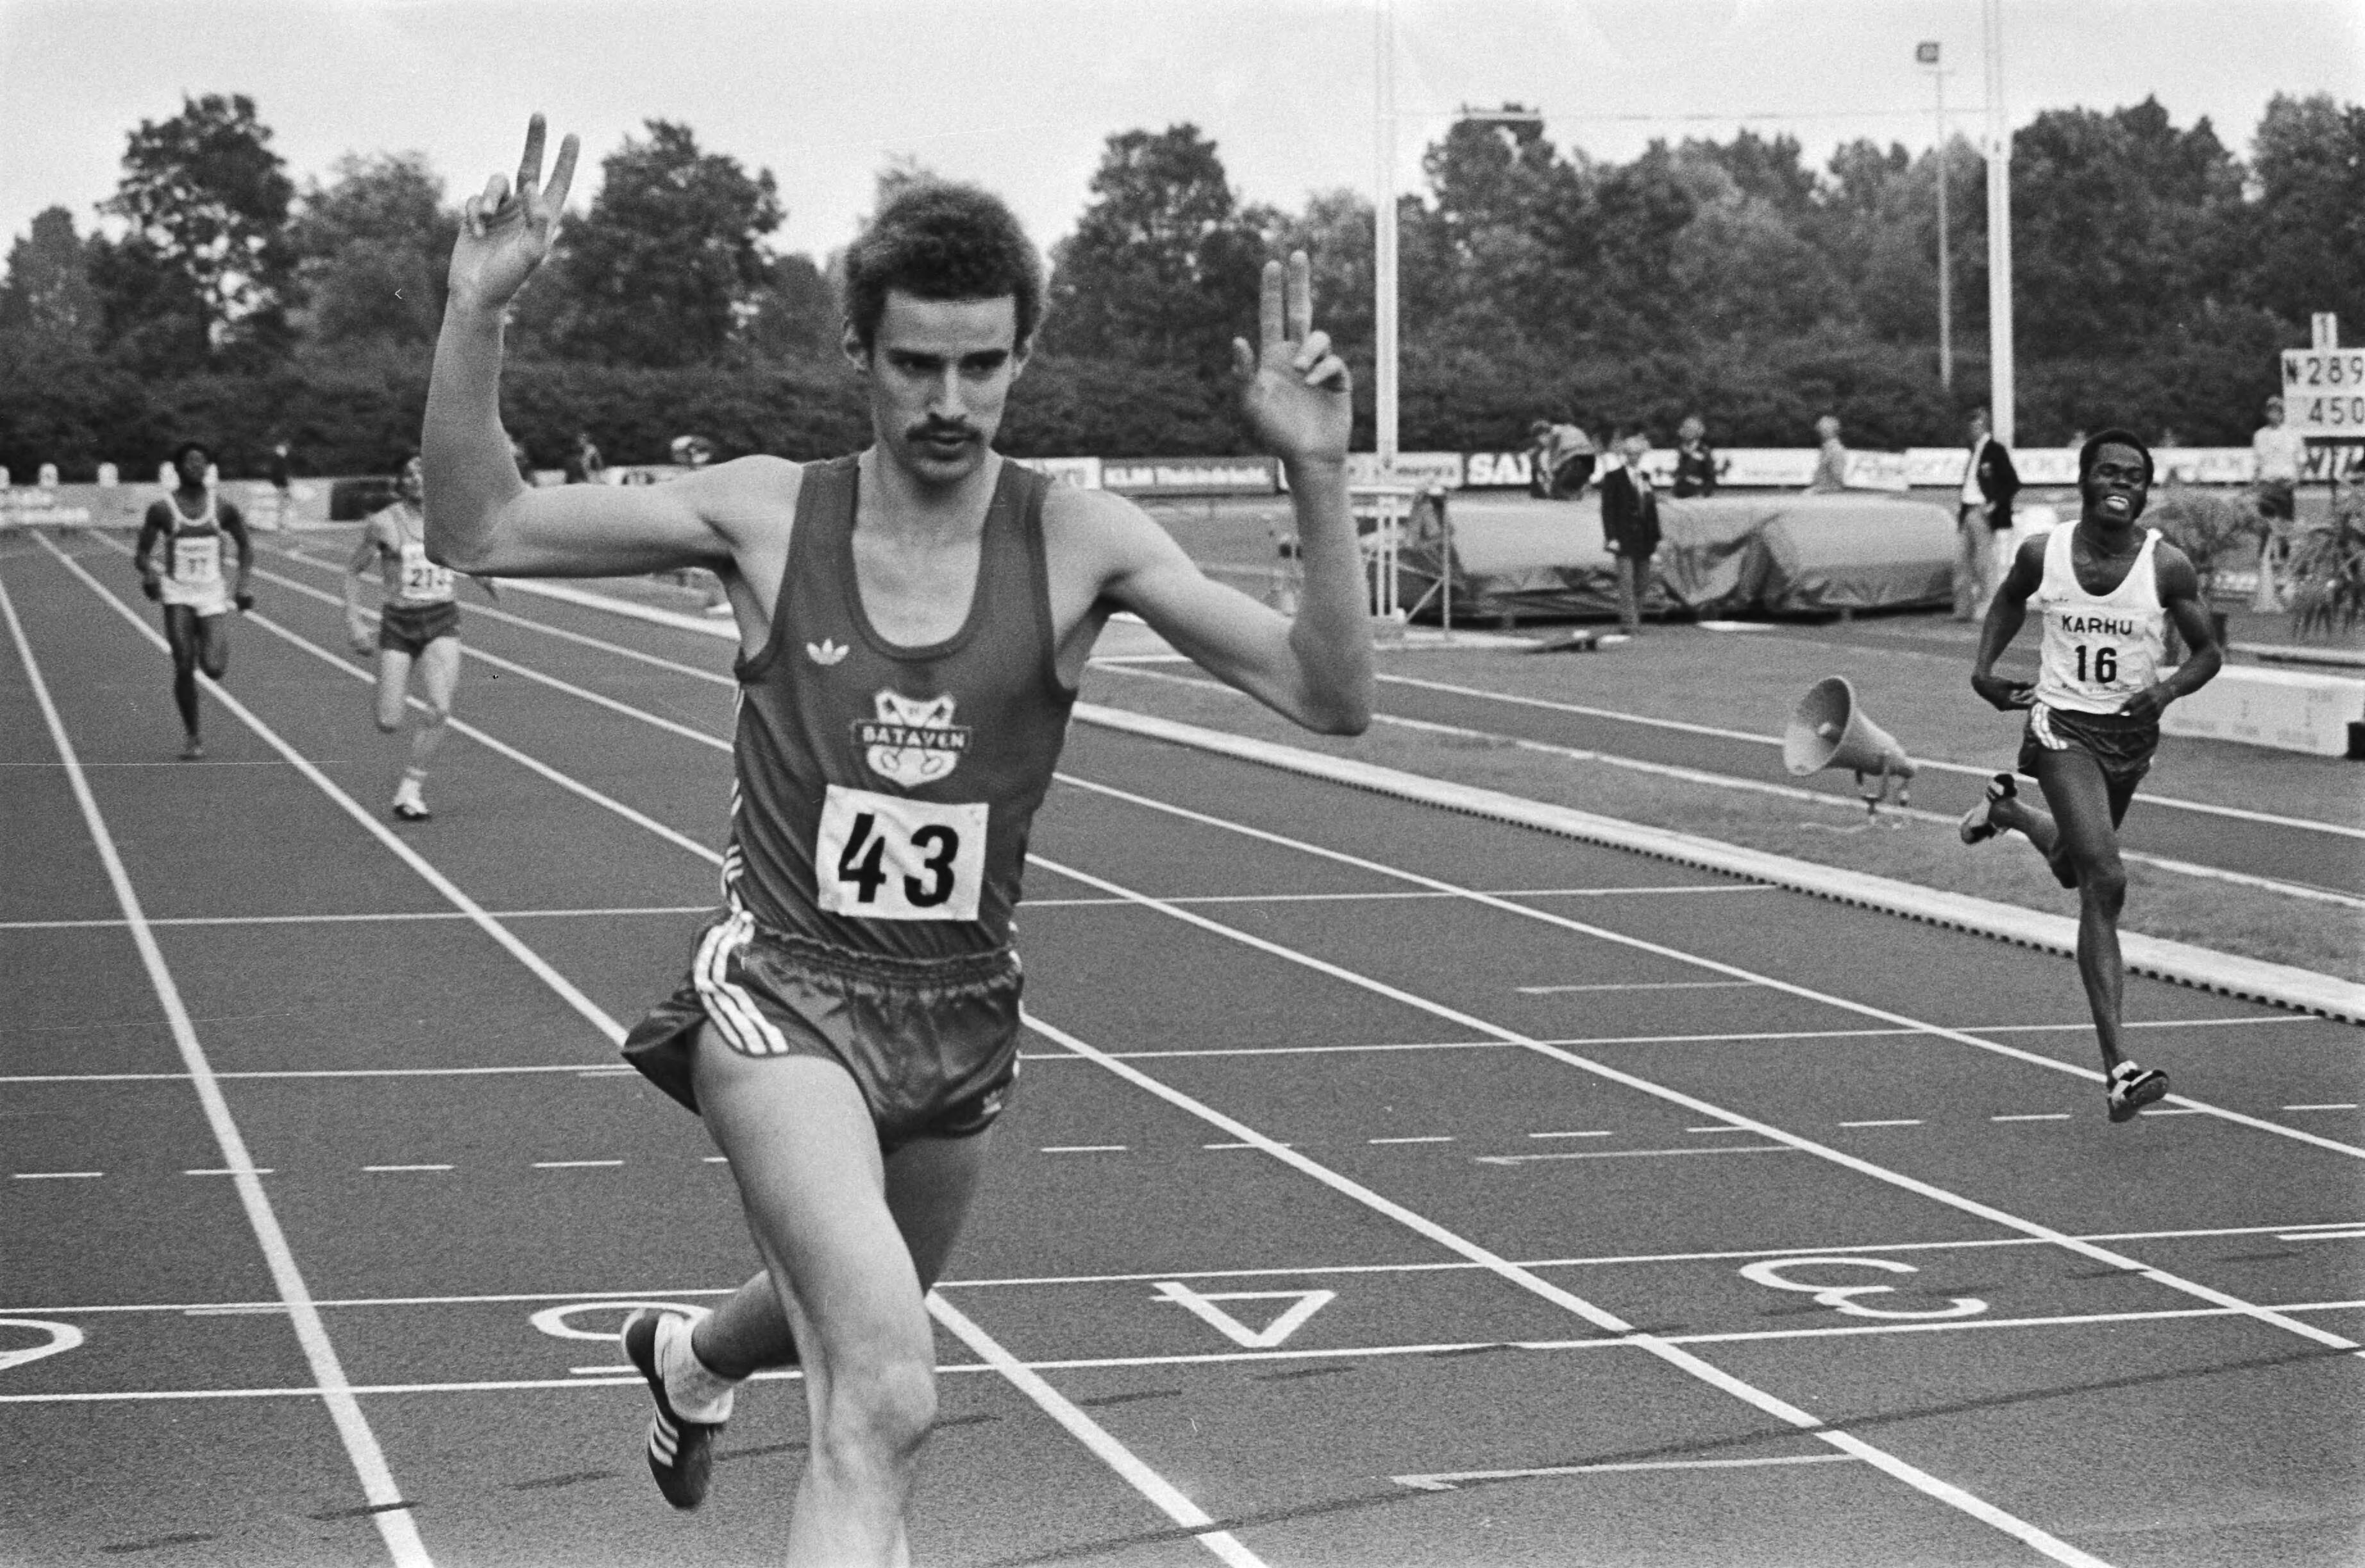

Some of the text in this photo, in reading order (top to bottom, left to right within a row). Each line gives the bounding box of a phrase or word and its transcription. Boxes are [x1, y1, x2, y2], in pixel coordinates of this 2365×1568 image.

[2307, 357, 2363, 385] 289
[2309, 396, 2365, 425] 450
[2062, 614, 2132, 635] KARHU
[2075, 645, 2117, 684] 16
[838, 813, 959, 907] 43
[1738, 1257, 1988, 1319] 3
[1149, 1282, 1338, 1347] 4
